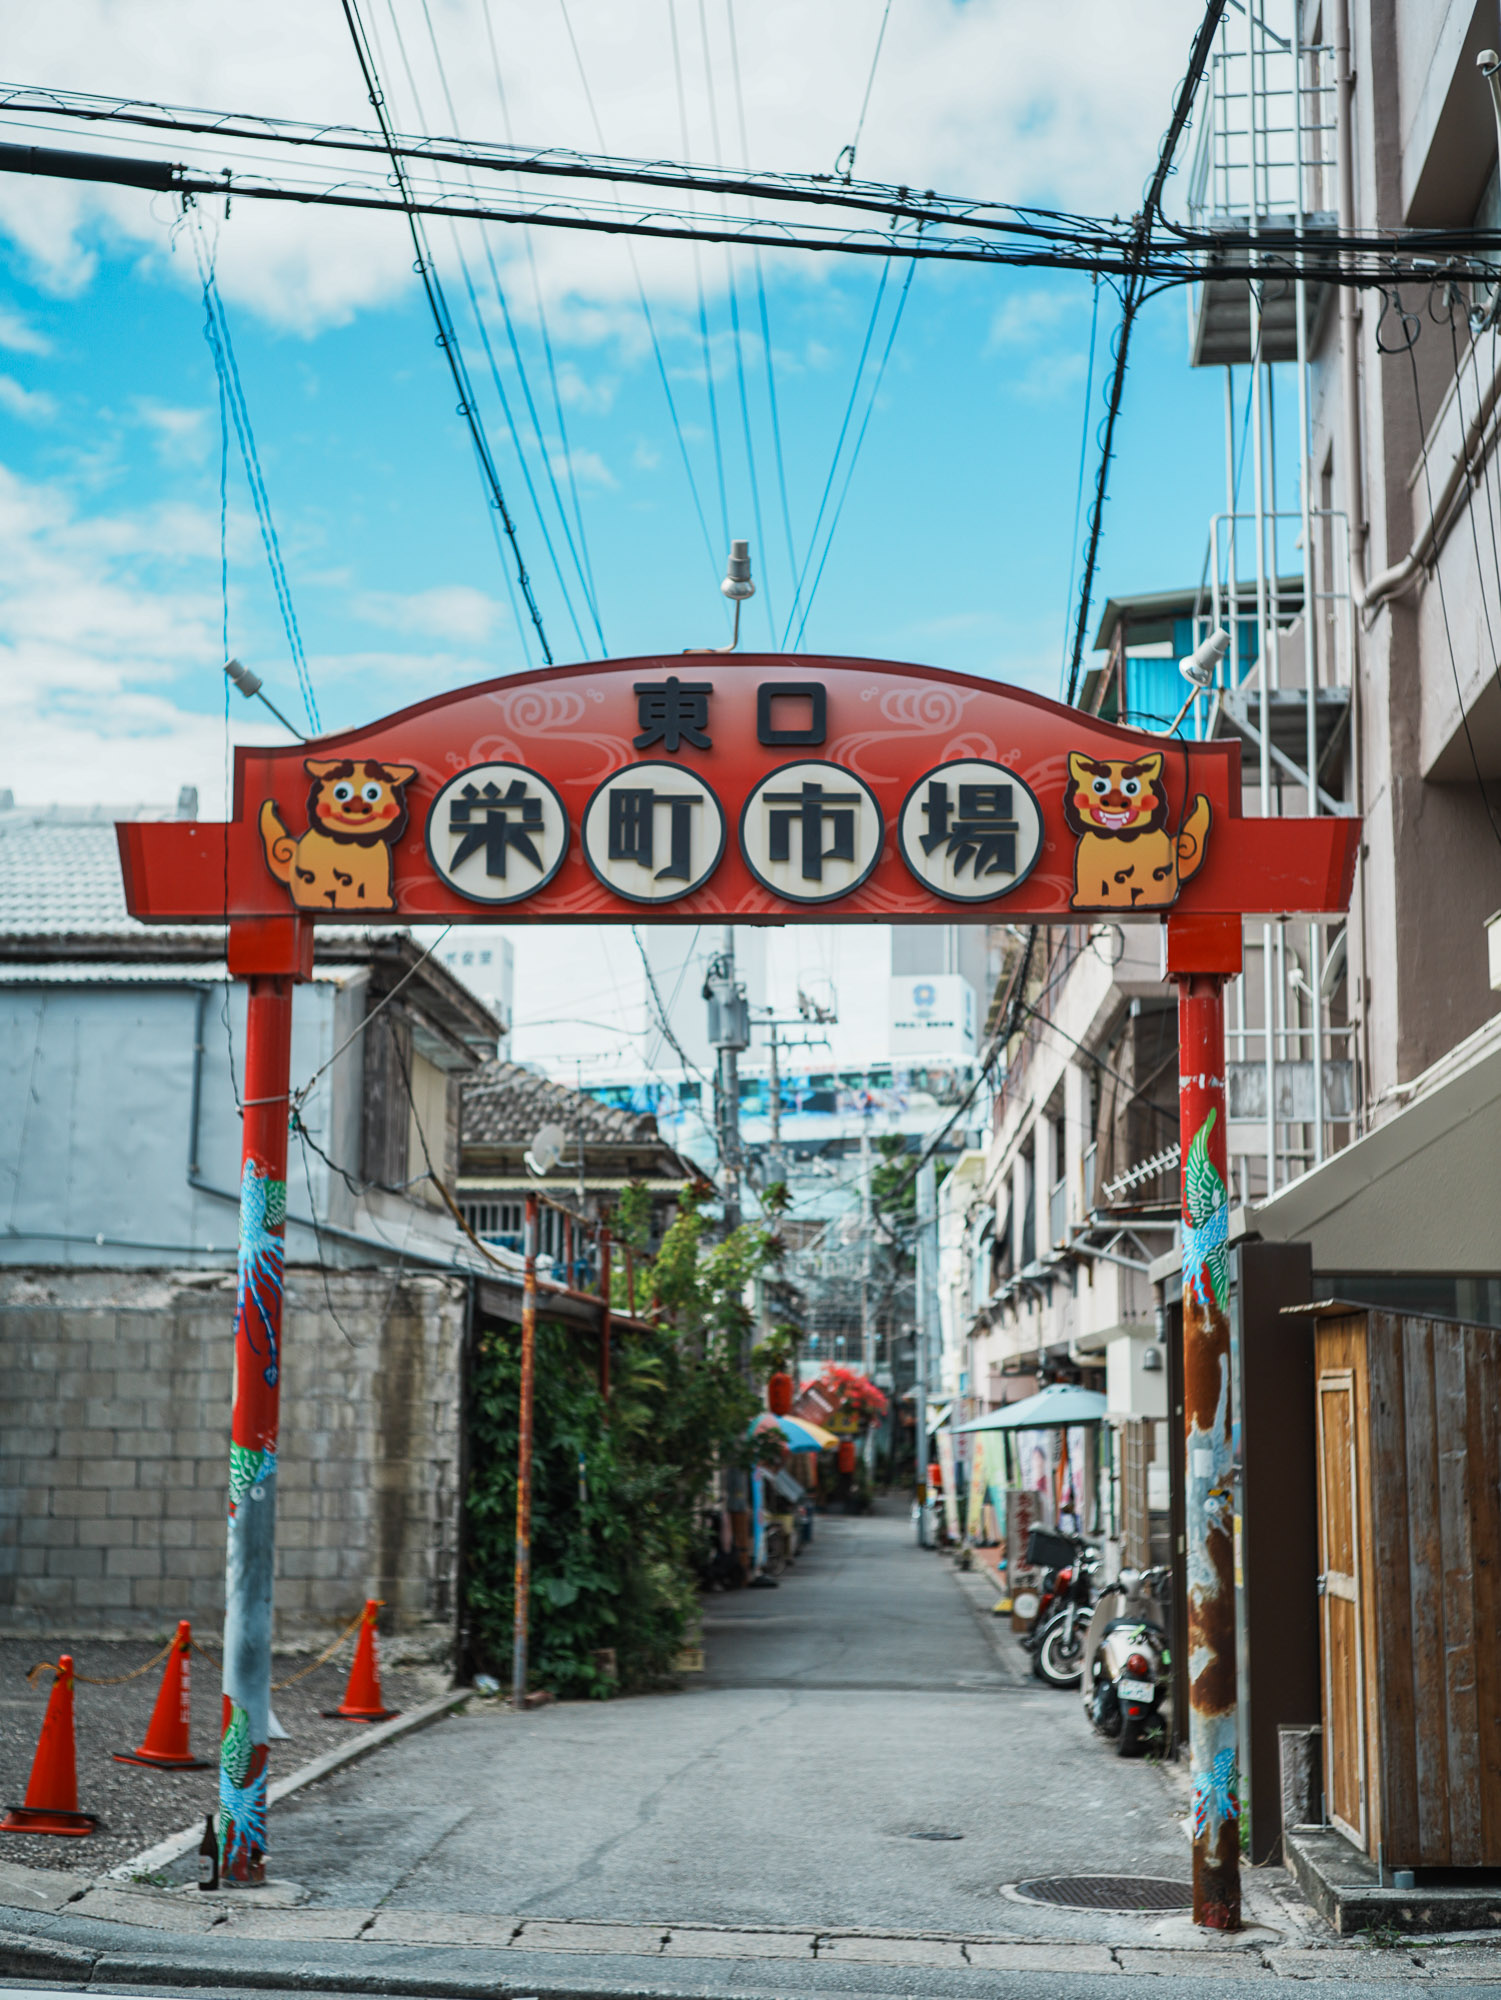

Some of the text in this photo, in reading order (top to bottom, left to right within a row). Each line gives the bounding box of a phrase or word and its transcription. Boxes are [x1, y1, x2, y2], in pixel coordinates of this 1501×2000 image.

[633, 676, 827, 752] 東口
[449, 779, 1020, 881] 栄町市場
